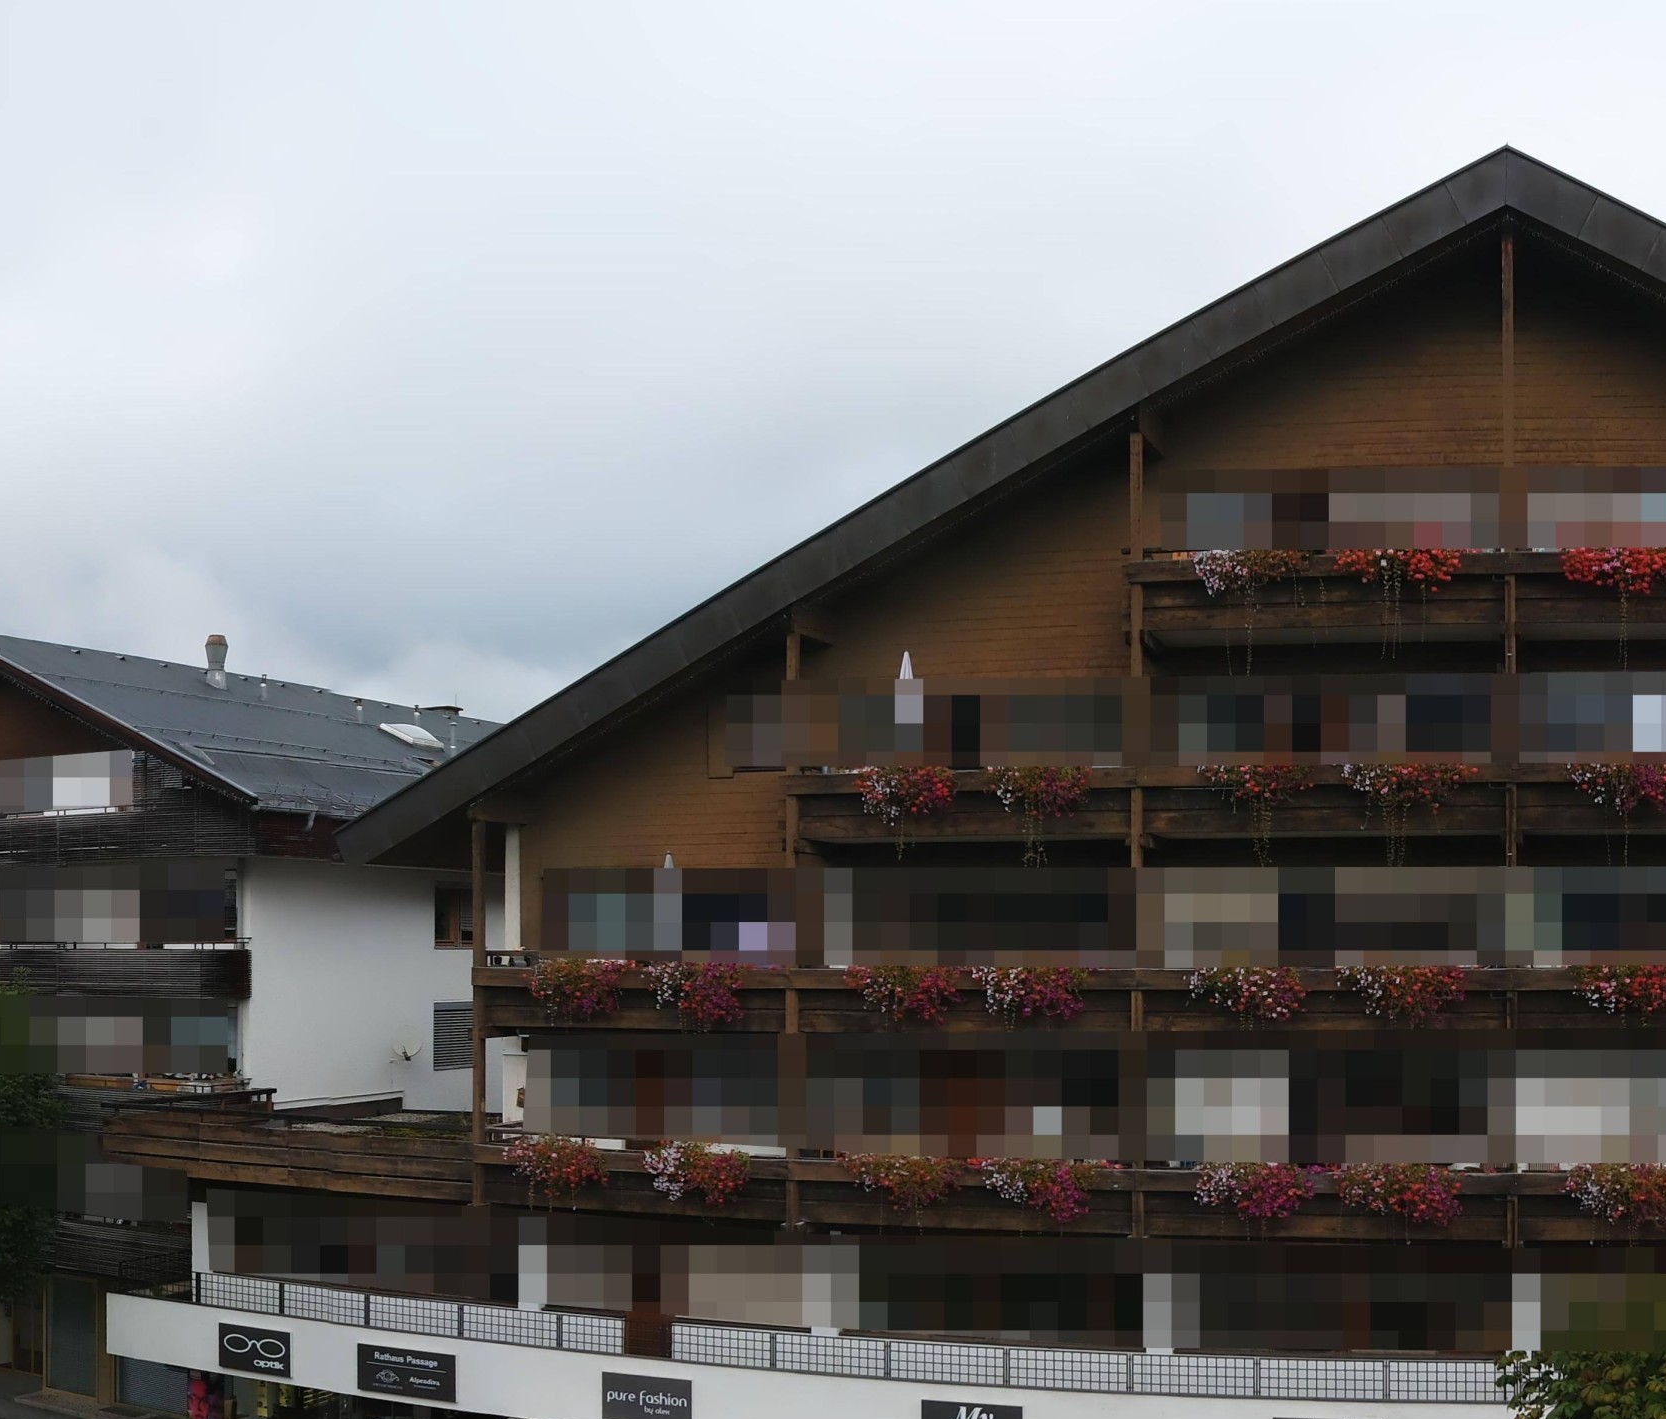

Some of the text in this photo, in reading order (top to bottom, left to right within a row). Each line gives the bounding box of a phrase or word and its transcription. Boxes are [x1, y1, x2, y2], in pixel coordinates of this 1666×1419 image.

[253, 1358, 284, 1370] optik
[374, 1351, 438, 1368] Rathaus Passage
[606, 1390, 687, 1407] pure fashion
[644, 1405, 653, 1415] by
